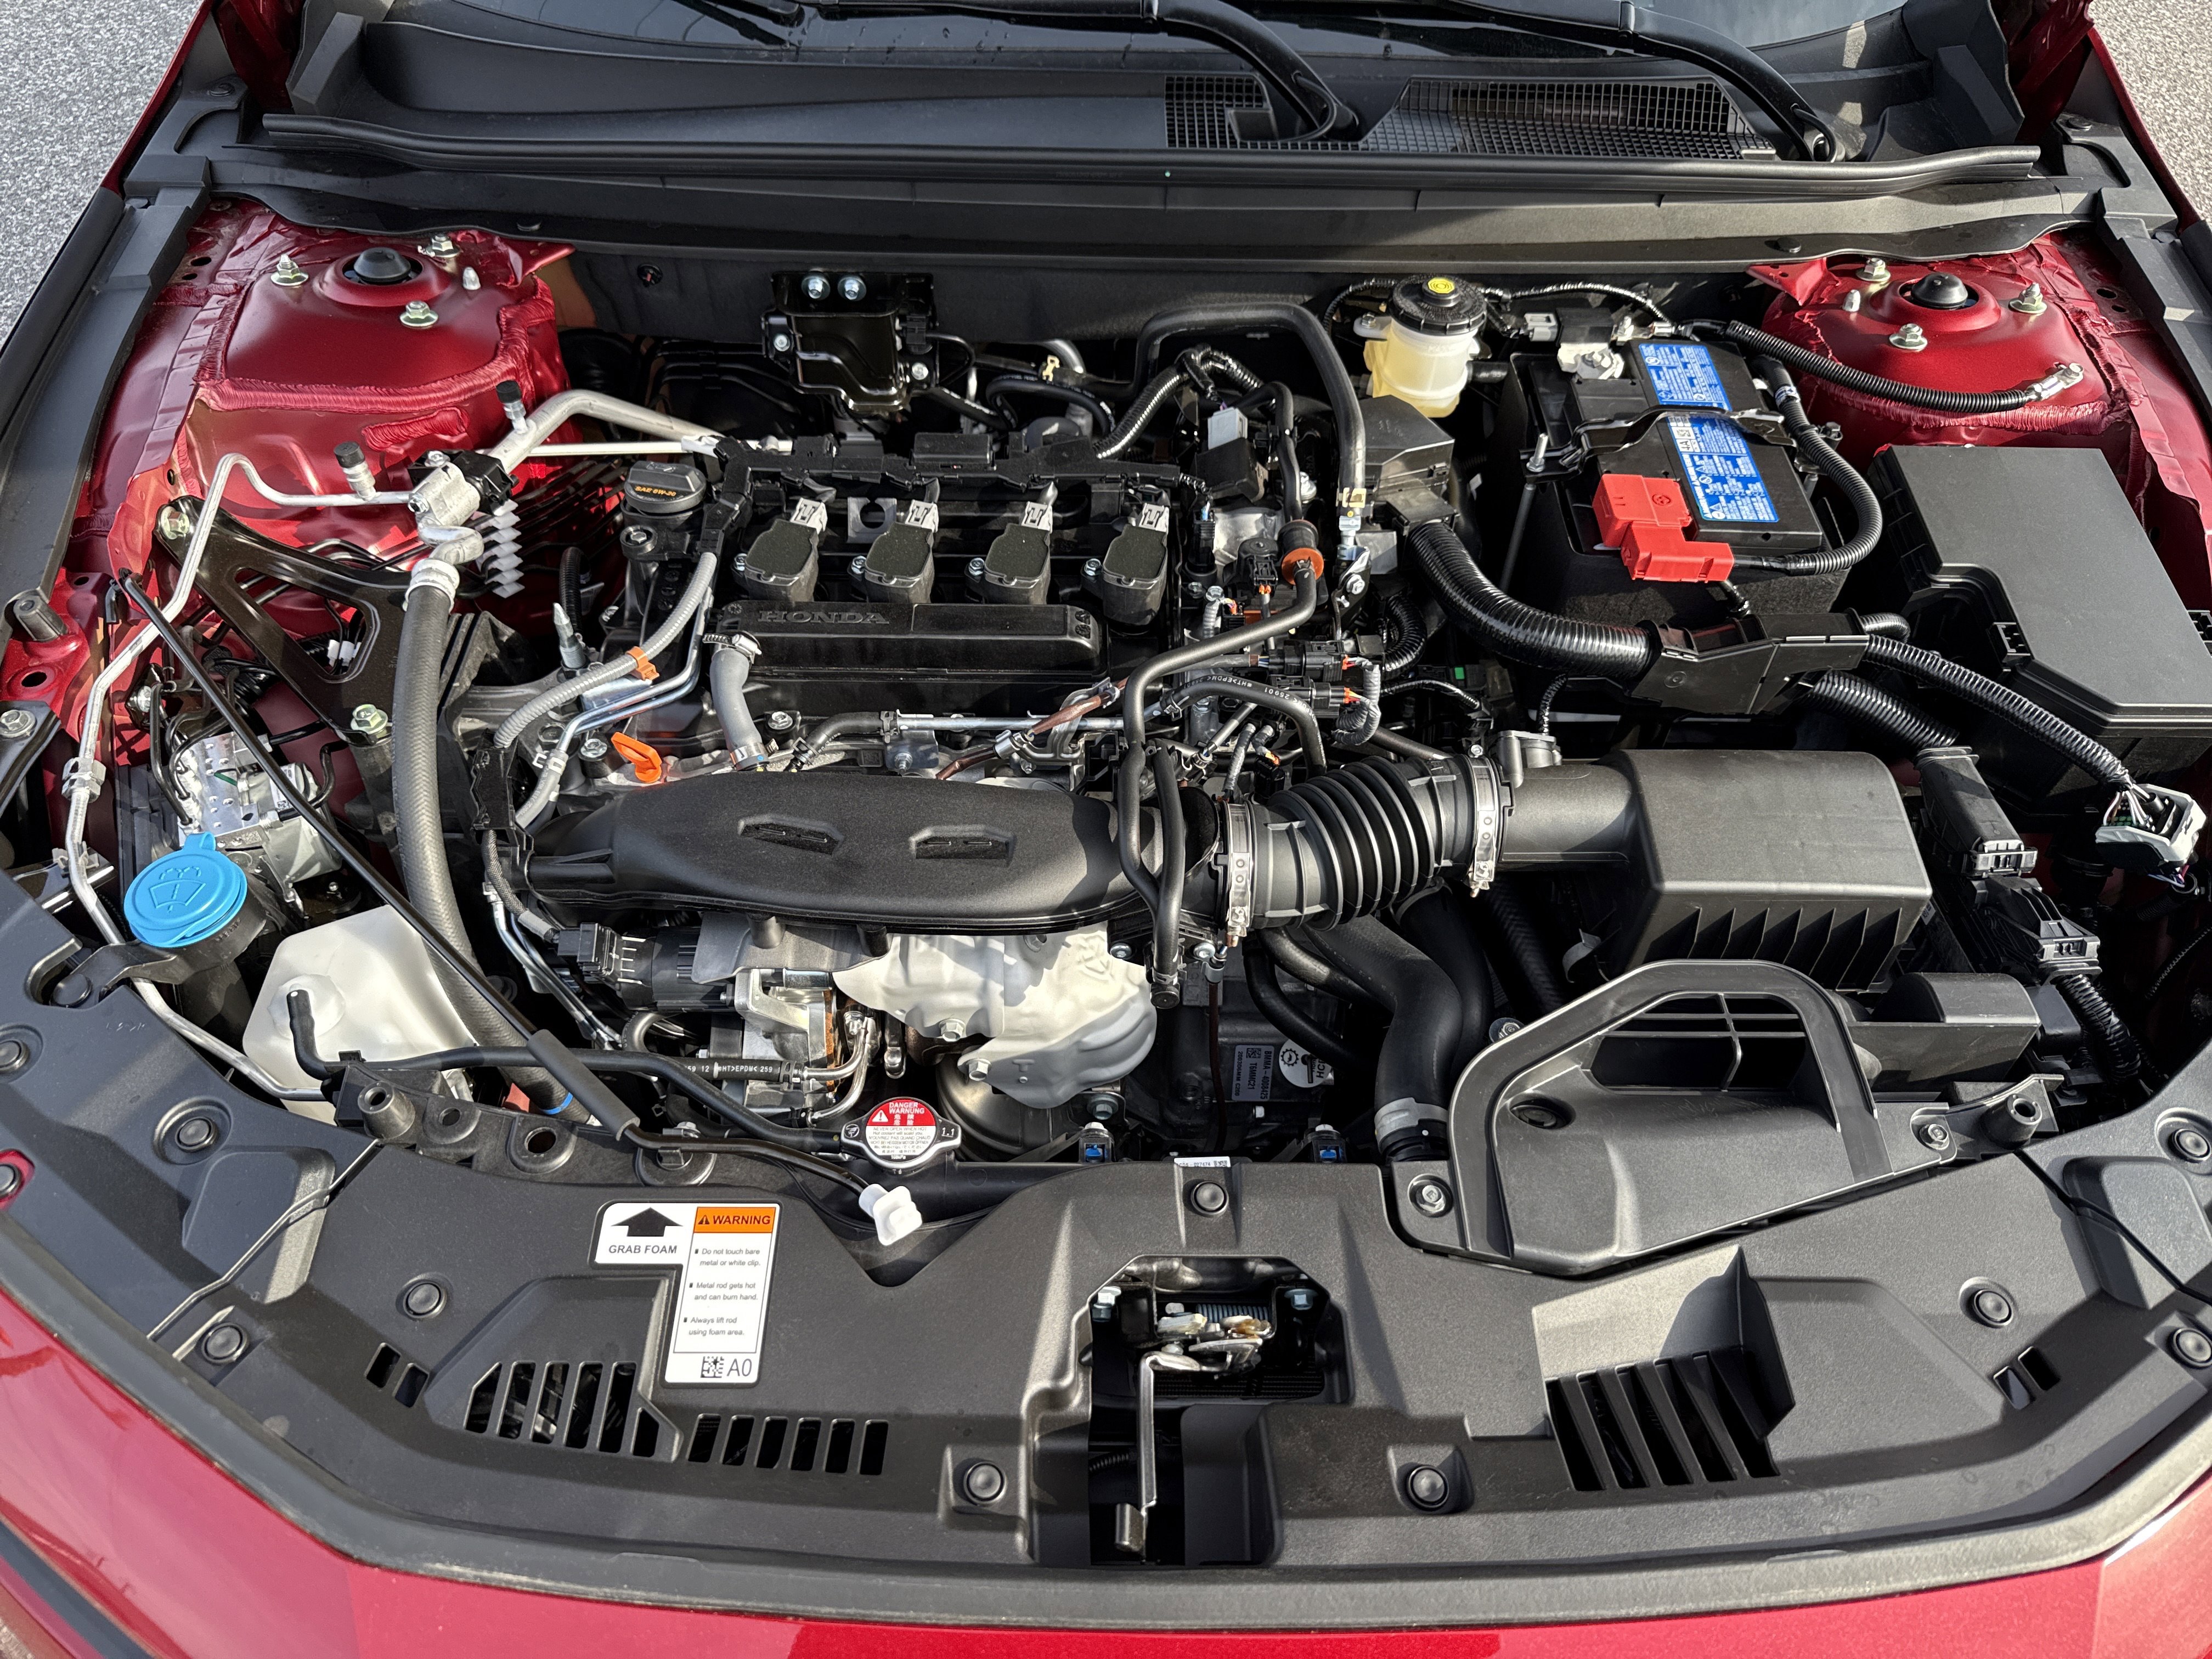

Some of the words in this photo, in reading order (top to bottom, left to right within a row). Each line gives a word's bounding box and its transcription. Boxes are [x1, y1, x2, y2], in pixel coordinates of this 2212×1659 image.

[758, 611, 889, 624] HONDA
[1248, 1063, 1257, 1090] T6MMC21
[942, 1127, 955, 1136] 1.1
[713, 1215, 771, 1225] WARNING
[608, 1245, 641, 1254] GRAB
[645, 1245, 677, 1254] FOAM
[727, 1358, 752, 1376] A0
